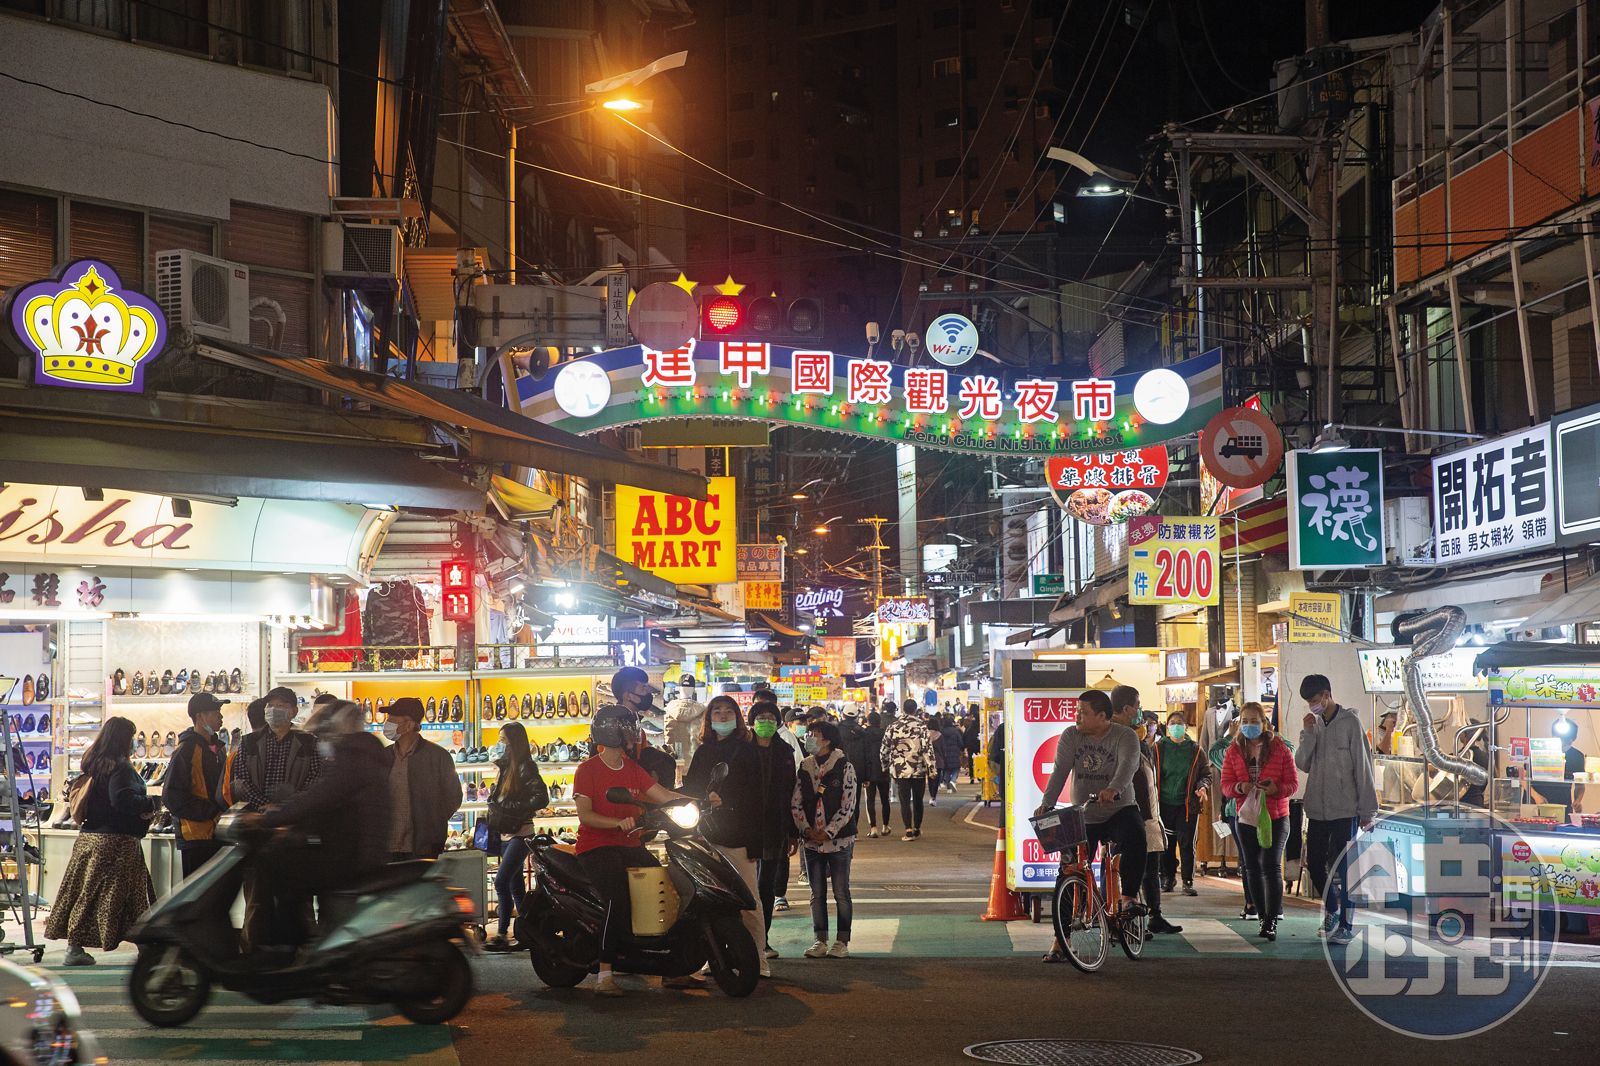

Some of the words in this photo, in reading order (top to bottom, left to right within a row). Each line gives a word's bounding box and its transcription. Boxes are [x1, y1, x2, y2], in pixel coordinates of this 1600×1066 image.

[612, 276, 625, 321] 禁止進入
[932, 343, 973, 356] Wi-Fi
[642, 338, 1116, 423] 逢甲國際觀光夜市
[903, 427, 950, 446] Feng
[953, 434, 997, 449] Chia
[999, 437, 1052, 451] Night
[1055, 432, 1124, 450] Market
[710, 447, 721, 476] 行李
[1058, 465, 1160, 486] 藥燉排骨
[1437, 438, 1548, 535] 開拓者
[632, 494, 721, 536] ABC
[1301, 466, 1377, 552] 襪
[1158, 524, 1217, 540] 防皺襯衫
[1440, 537, 1461, 558] 西服
[1468, 525, 1514, 552] 男女襯衫
[1521, 517, 1548, 540] 領帶
[632, 541, 721, 568] MART
[1154, 548, 1214, 599] 200
[1535, 673, 1574, 701] 米樂
[1530, 863, 1577, 899] 米樂
